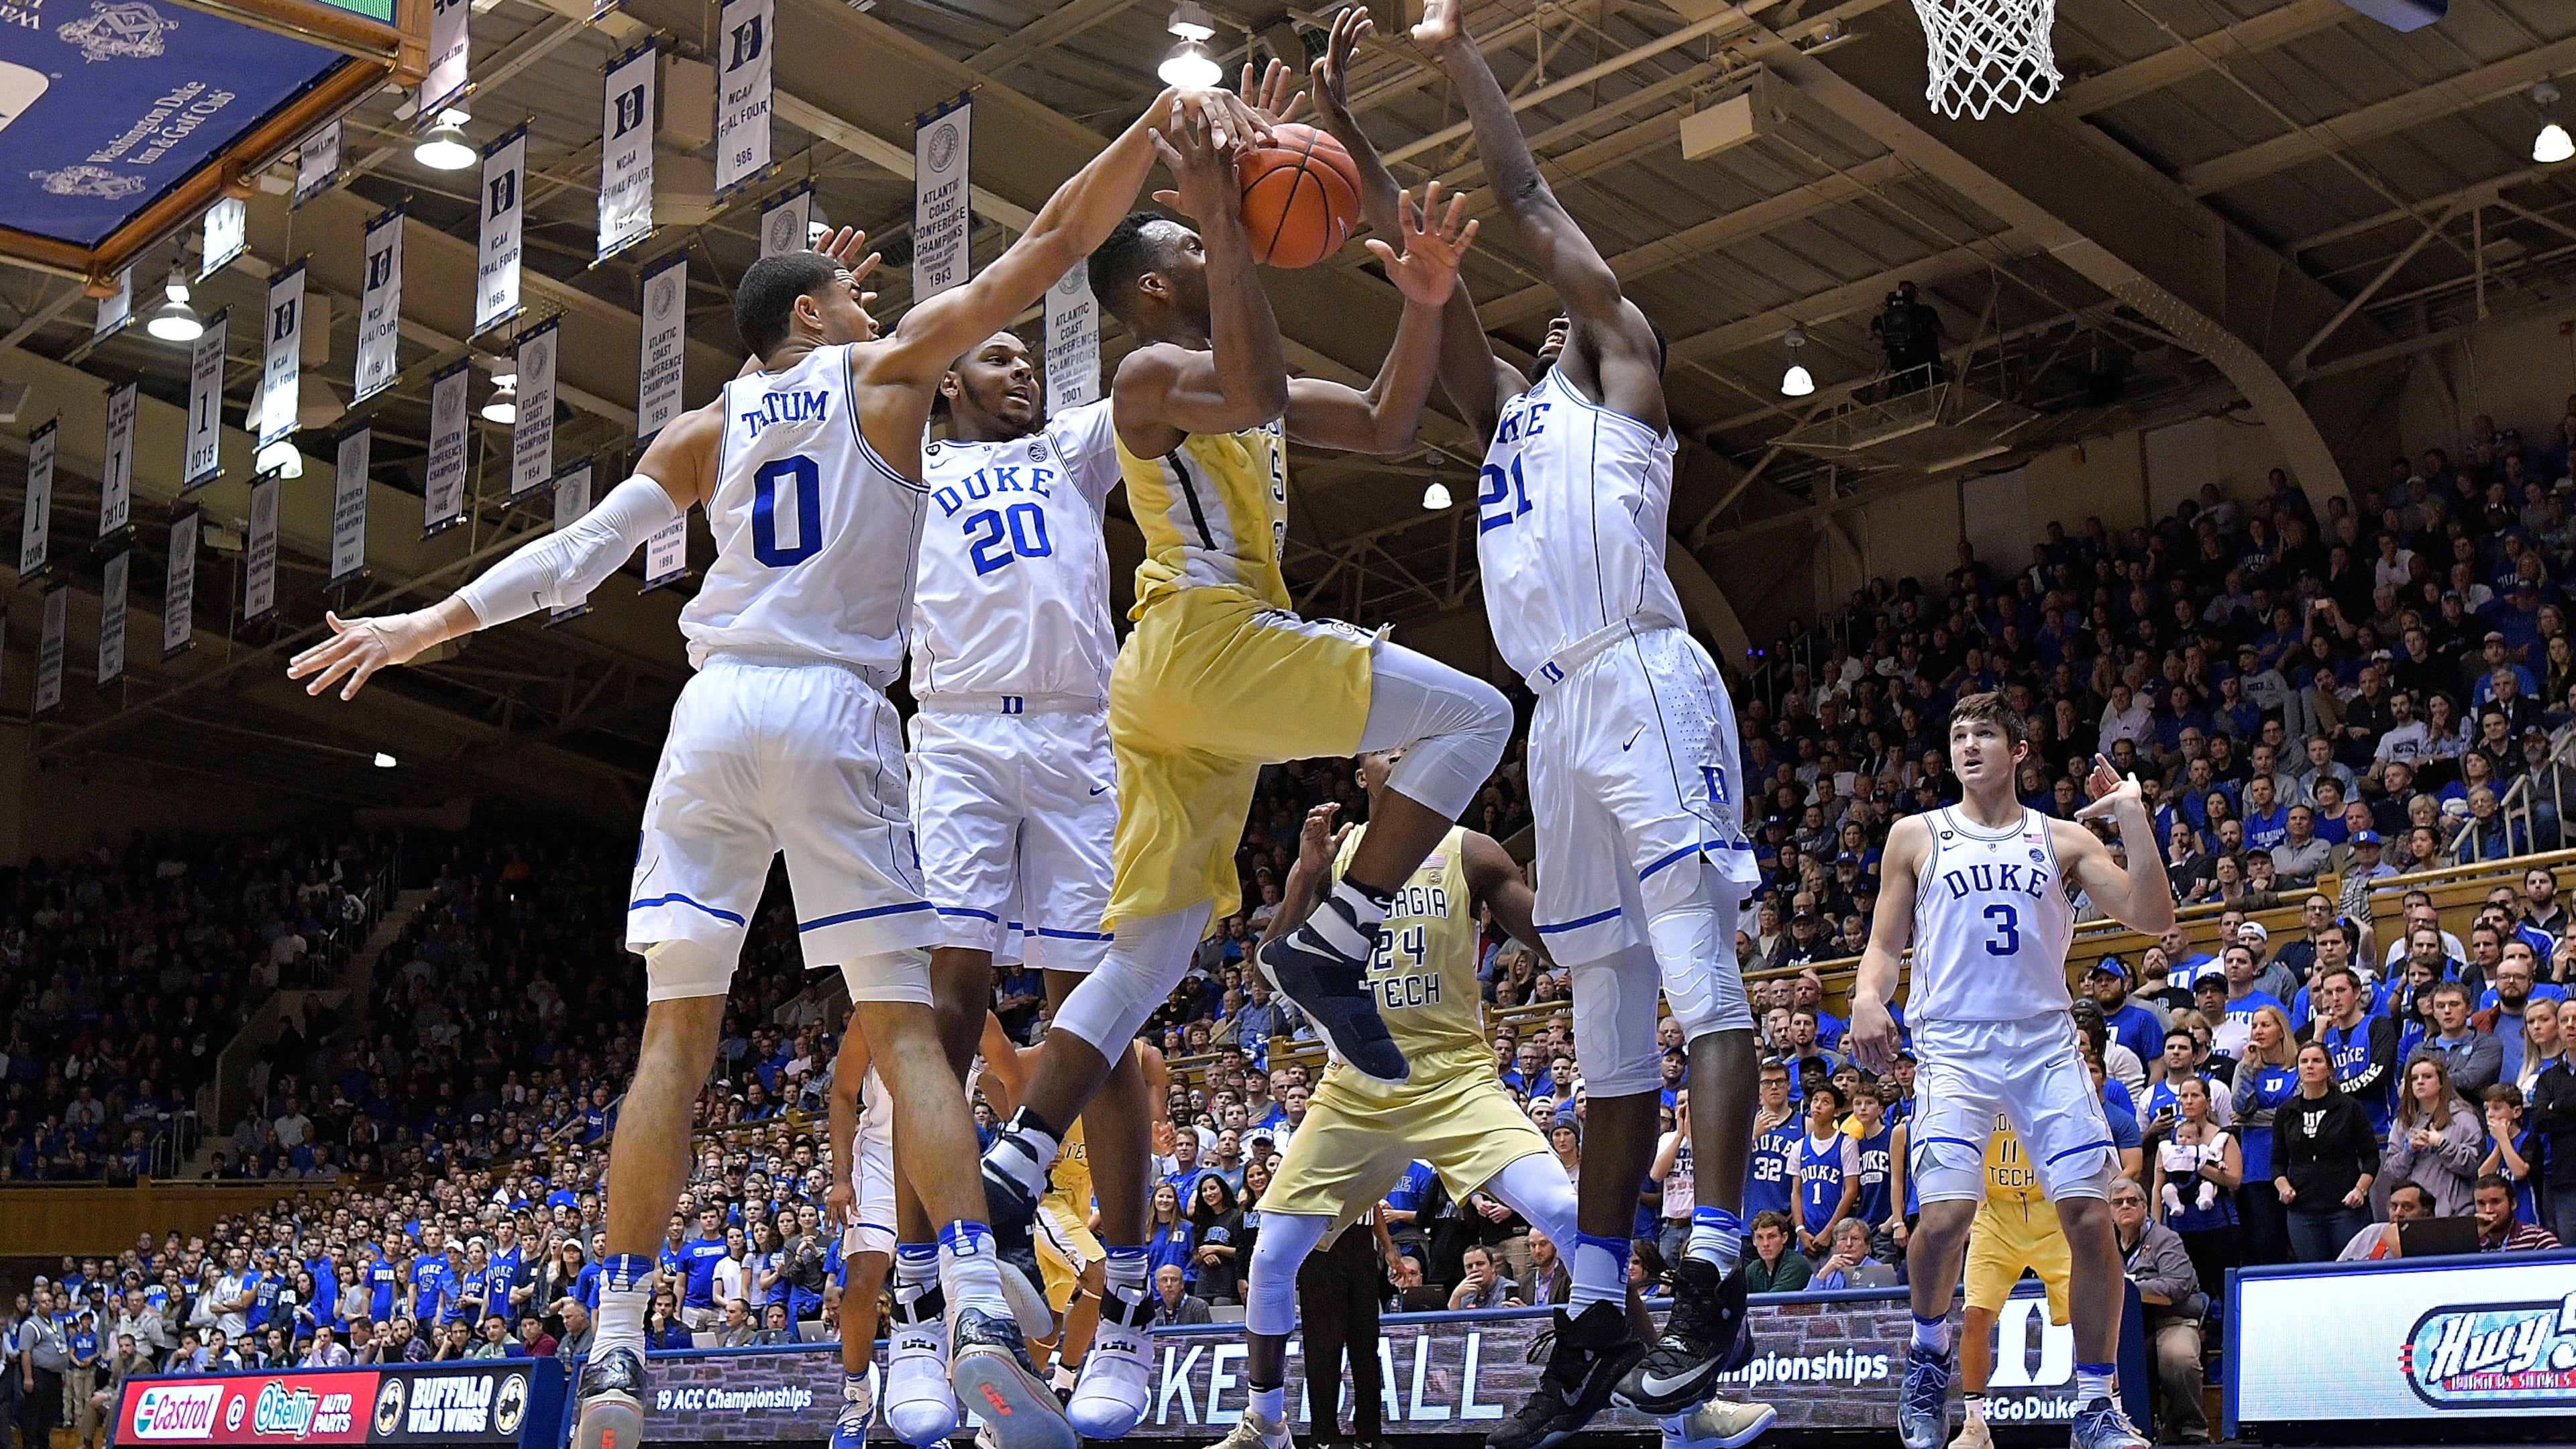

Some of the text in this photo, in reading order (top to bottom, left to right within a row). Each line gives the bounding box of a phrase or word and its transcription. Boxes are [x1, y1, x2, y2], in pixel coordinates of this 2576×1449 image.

[86, 81, 206, 162] Washington Duke
[741, 101, 767, 123] FOUR
[127, 89, 235, 164] Inn & Golf Club
[616, 149, 637, 172] NCAA
[733, 148, 752, 170] 1986
[628, 167, 650, 189] FOUR
[922, 178, 959, 205] ATLANTIC
[929, 198, 955, 219] COAST
[916, 207, 966, 241] CONFERENCE
[491, 231, 508, 252] NCAA
[916, 224, 963, 257] CHAMPIONS
[480, 248, 518, 280] FINAL FOUR
[489, 290, 505, 309] 1966
[1055, 302, 1089, 328] ATLANTIC
[649, 327, 677, 350] ATLANTIC
[1061, 320, 1083, 340] COAST
[653, 343, 671, 362] COAST
[1048, 330, 1097, 361] CONFERENCE
[273, 354, 288, 370] NCAA
[642, 354, 682, 382] CONFERENCE
[1049, 347, 1095, 376] CHAMPIONS
[280, 370, 297, 385] FOUR
[643, 370, 680, 396] CHAMPIONS
[522, 390, 548, 410] ATLANTIC
[1062, 386, 1081, 405] 2001
[198, 391, 208, 434] 1
[525, 406, 543, 423] COAST
[652, 407, 667, 423] 1958
[741, 392, 828, 439] TATUM
[1497, 403, 1550, 444] KE
[515, 415, 552, 441] CONFERENCE
[517, 431, 549, 455] CHAMPIONS
[112, 450, 121, 491] 1
[931, 466, 1055, 519] DUKE
[1479, 452, 1533, 538] 21
[33, 494, 40, 532] 1
[751, 455, 822, 569] 0
[962, 503, 1053, 577] 20
[1943, 864, 2048, 900] DUKE
[1384, 887, 1449, 920] RGIA
[1982, 904, 2020, 956] 3
[1372, 924, 1426, 973] 24
[1367, 973, 1441, 1009] TECH
[2340, 1062, 2383, 1094] DUKE
[2000, 1138, 2018, 1164] 11
[1754, 1157, 1782, 1182] 32
[1801, 1164, 1840, 1185] DUKE
[1988, 1165, 2035, 1187] TECH
[1813, 1182, 1821, 1205] 1
[418, 1264, 443, 1276] DUKE
[490, 1265, 513, 1280] DUKE
[494, 1278, 504, 1293] 3
[2425, 1312, 2552, 1385] Hwy
[319, 1394, 352, 1412] AUTO
[410, 1375, 494, 1409] BUFFALO
[656, 1385, 812, 1413] 19 ACC Championships
[154, 1393, 215, 1431] Castrol
[225, 1394, 246, 1432] @
[407, 1408, 488, 1433] WILD WINGS
[1982, 1395, 2079, 1421] #GoDuke
[312, 1413, 352, 1433] PARTS
